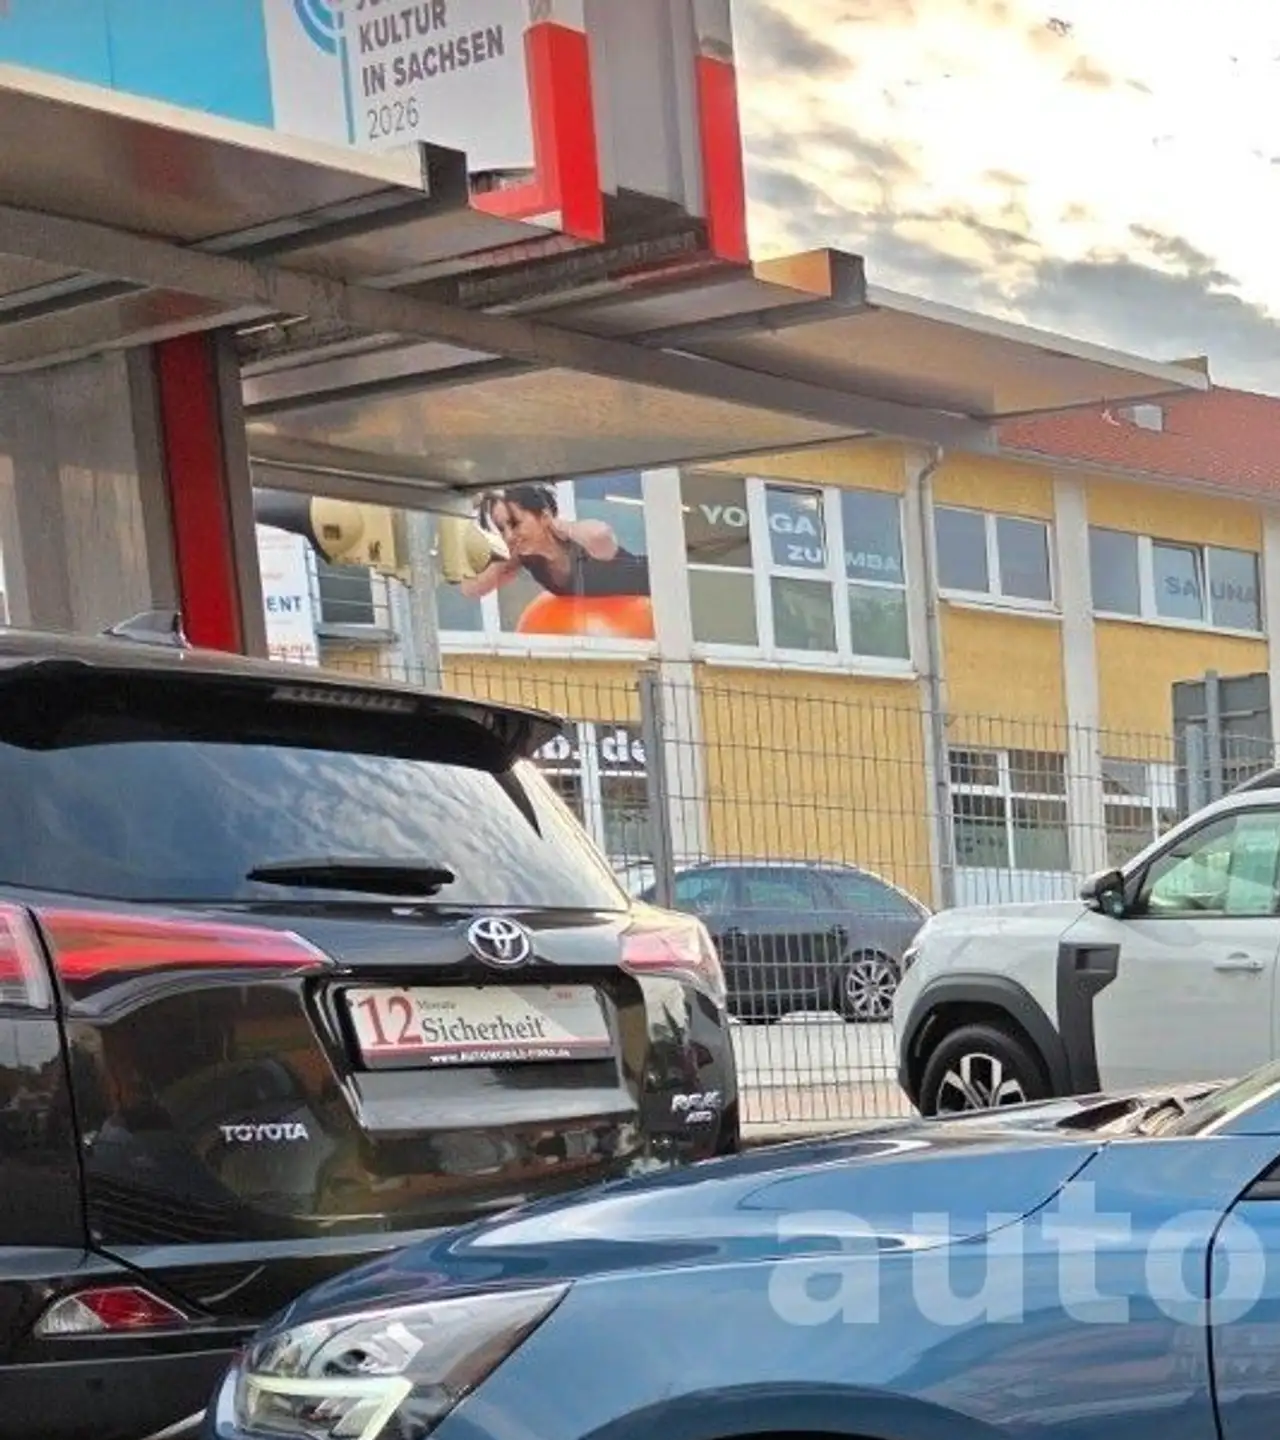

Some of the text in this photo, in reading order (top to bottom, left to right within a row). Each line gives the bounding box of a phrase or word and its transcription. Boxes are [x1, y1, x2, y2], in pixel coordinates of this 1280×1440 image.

[359, 1, 447, 53] KULTUR
[362, 24, 505, 97] IN SACHSEN
[366, 97, 420, 139] 2026
[358, 995, 423, 1046] 12
[421, 1015, 549, 1043] Sicherheit
[220, 1122, 309, 1143] TOYOTA
